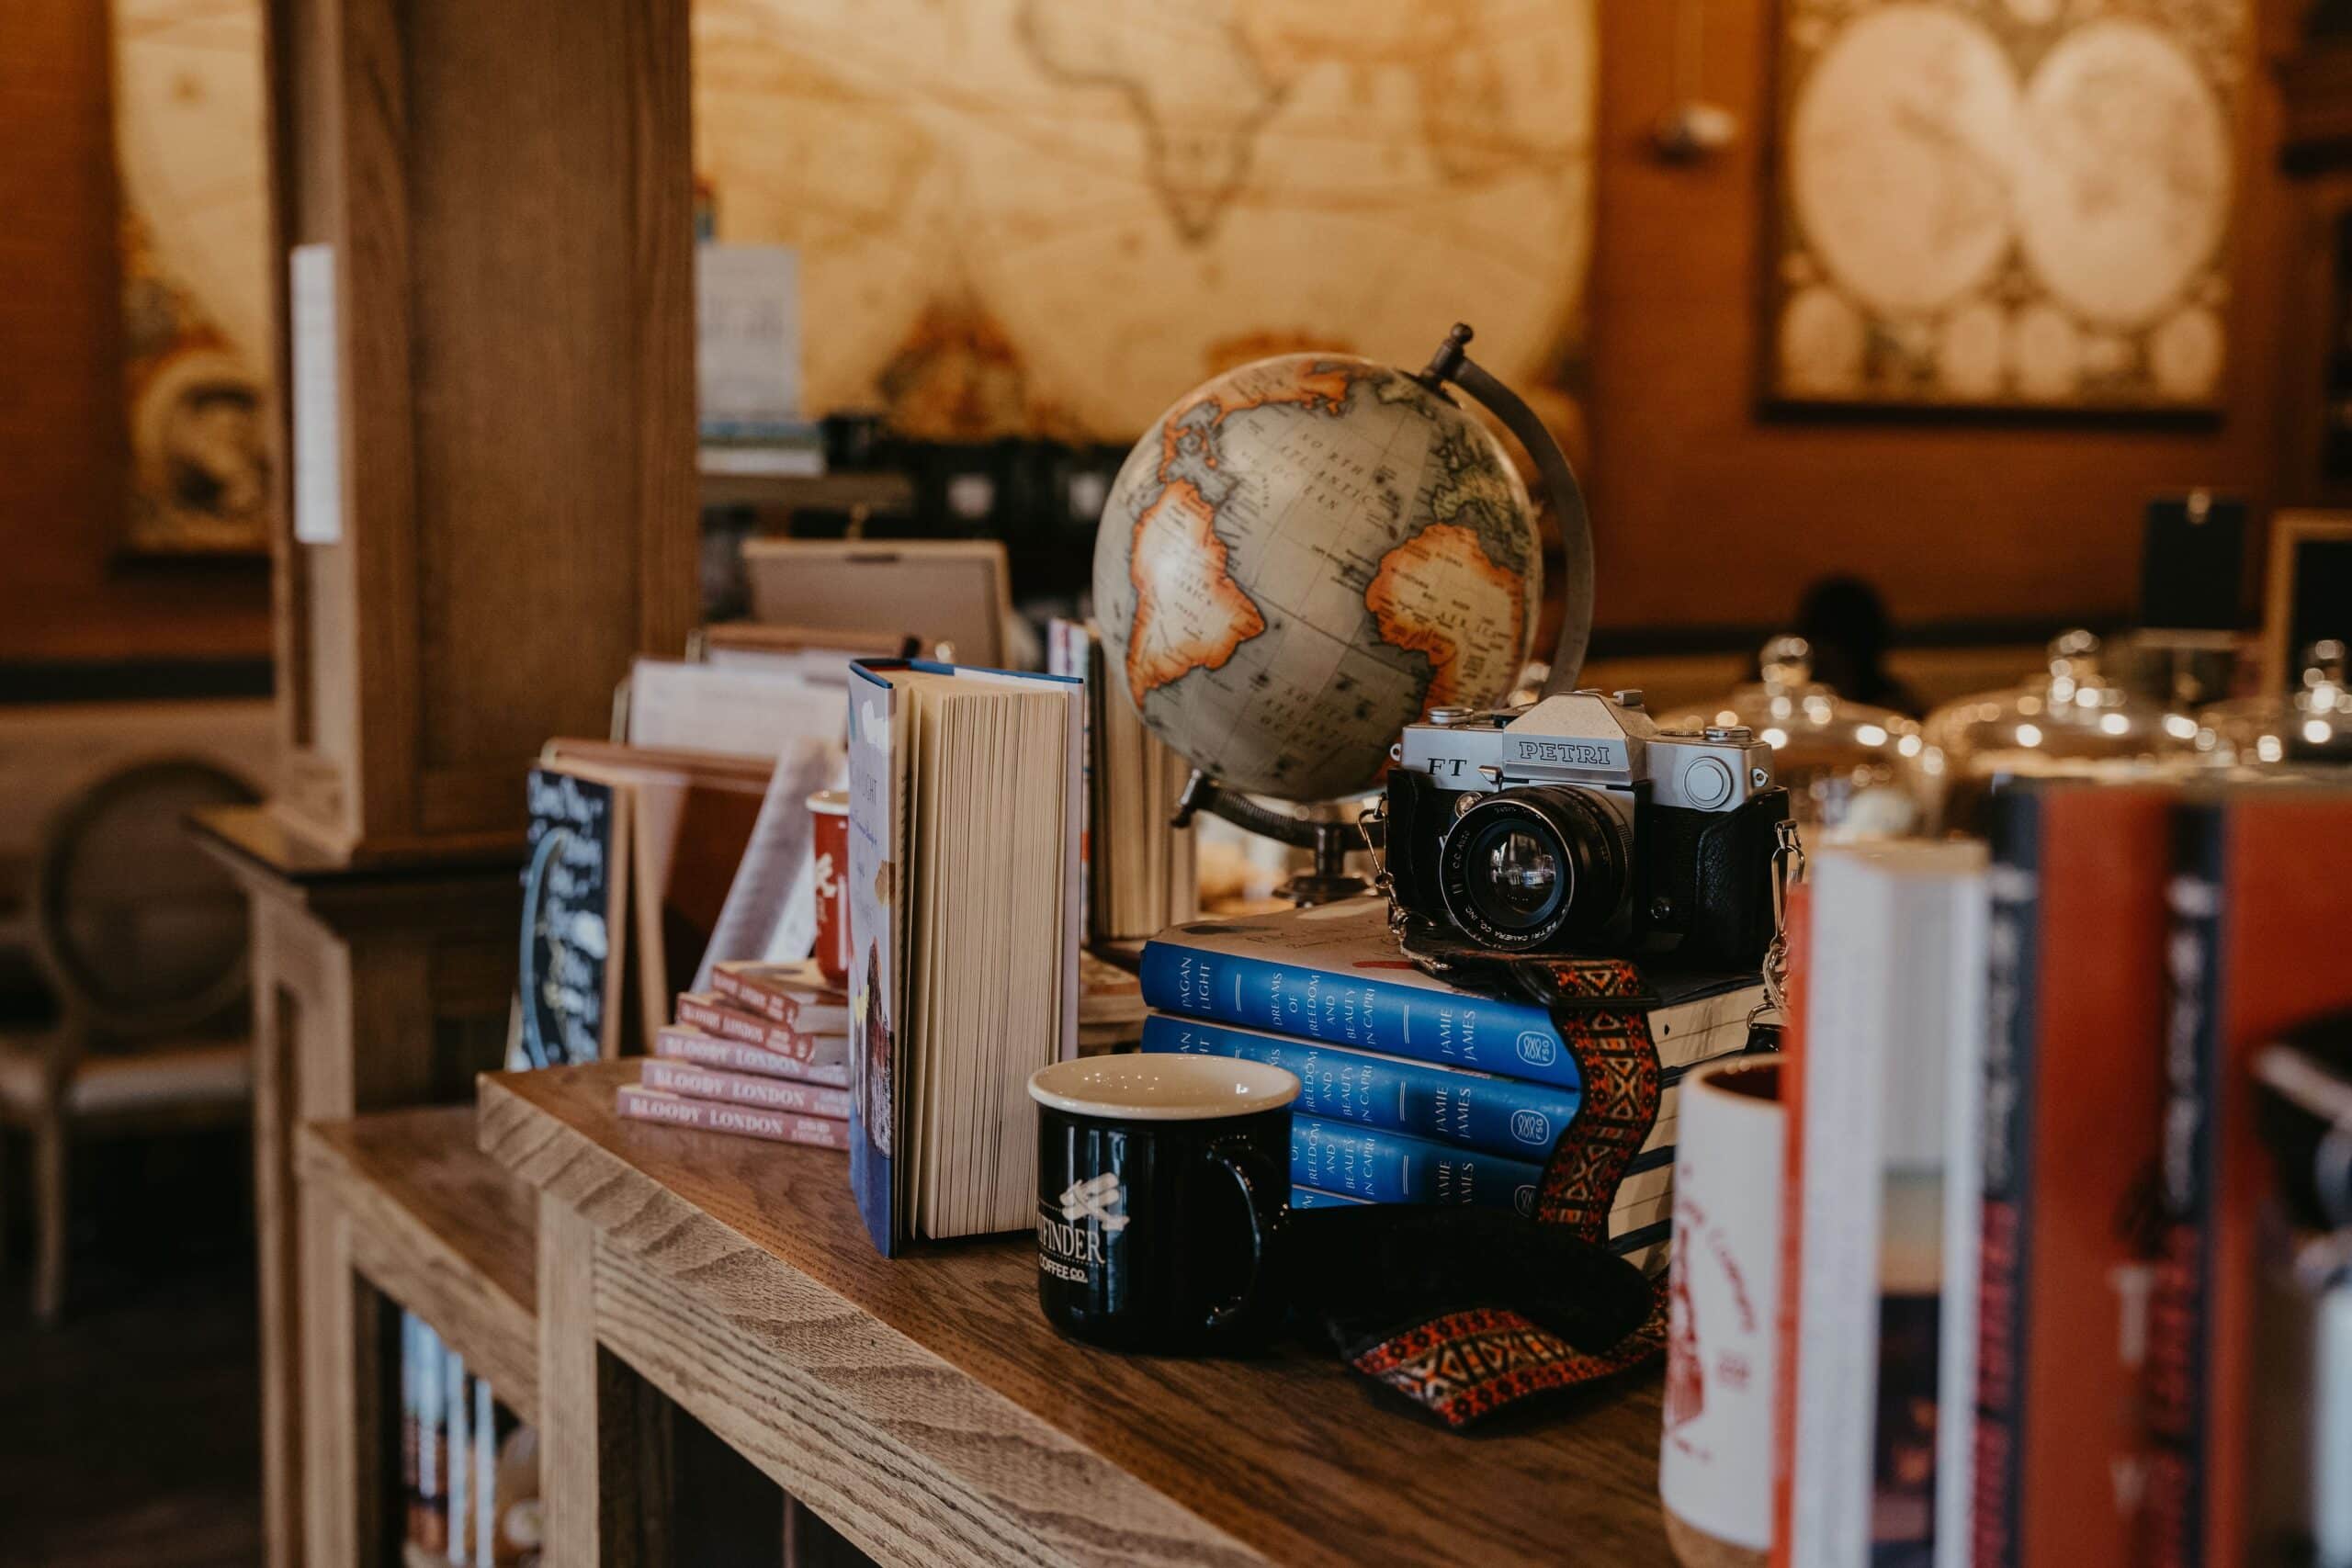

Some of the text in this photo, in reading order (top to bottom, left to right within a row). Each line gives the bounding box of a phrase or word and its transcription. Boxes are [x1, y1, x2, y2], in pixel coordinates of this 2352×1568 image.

[1427, 757, 1467, 777] FT
[1519, 741, 1610, 764] PETRI
[1179, 956, 1193, 1008] PAGAN
[1198, 963, 1212, 1010] LIGHT
[1271, 972, 1283, 1026] DREAMS
[1288, 993, 1298, 1013] OF
[1306, 975, 1321, 1037] FREEDOM
[1325, 995, 1336, 1025] AND
[1344, 988, 1357, 1039] BEAUTY
[1363, 987, 1376, 1044] IN CAPRI
[1440, 1006, 1455, 1055] JAMIE
[1462, 1010, 1477, 1061] JAMES
[1542, 1040, 1550, 1062] FSG
[737, 1047, 800, 1074] LONDON
[1304, 1051, 1318, 1112] FREEDOM
[653, 1068, 724, 1097] BLOODY
[731, 1083, 806, 1108] LONDON
[1322, 1072, 1333, 1101] AND
[1340, 1065, 1353, 1116] BEAUTY
[1360, 1065, 1373, 1122] IN CAPRI
[628, 1098, 702, 1124] BLOODY
[709, 1109, 784, 1134] LONDON
[1434, 1087, 1449, 1133] JAMIE
[1457, 1088, 1472, 1139] JAMES
[1535, 1118, 1544, 1140] FSG
[1307, 1123, 1321, 1186] FREEDOM
[1326, 1144, 1336, 1174] AND
[1344, 1138, 1355, 1189] BEAUTY
[1363, 1138, 1375, 1195] IN CAPRI
[1438, 1160, 1452, 1200] AMIE
[1460, 1161, 1475, 1204] AMES
[1038, 1253, 1069, 1280] COFFEE
